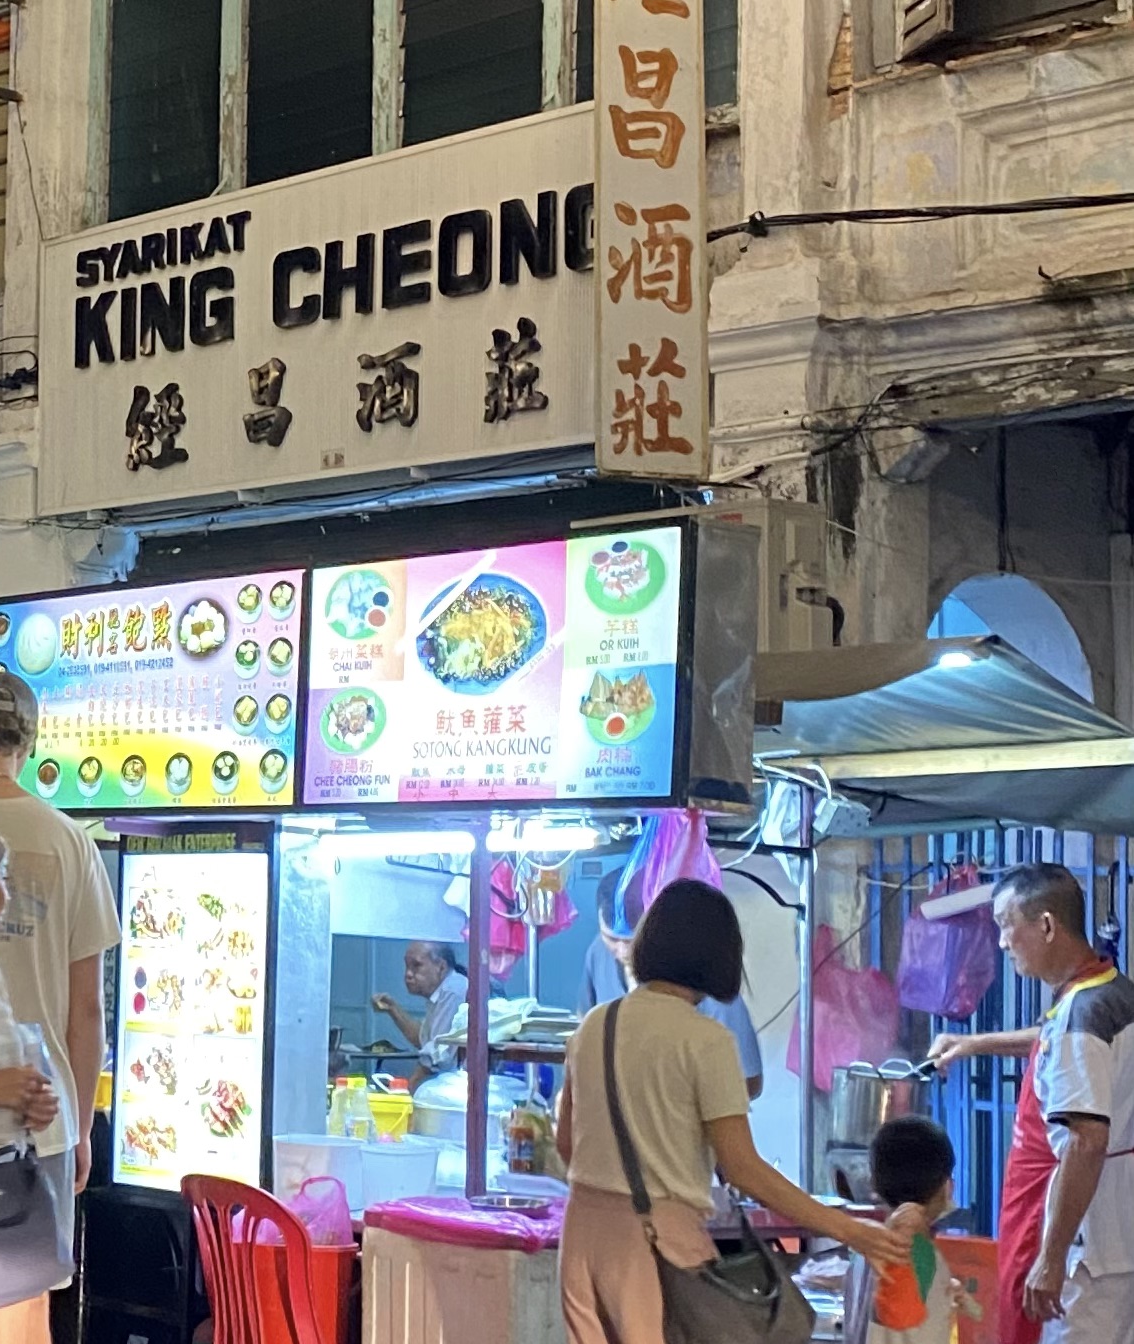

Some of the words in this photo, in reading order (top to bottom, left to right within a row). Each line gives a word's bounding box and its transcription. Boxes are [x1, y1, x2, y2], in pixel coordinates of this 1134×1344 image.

[76, 210, 252, 289] SYARIKAT
[74, 266, 235, 369] KING
[600, 640, 614, 651] OR
[617, 638, 640, 650] KUIH
[333, 661, 352, 673] CHAI
[413, 740, 461, 759] SOTONG
[466, 736, 552, 757] KANGKUNG
[585, 766, 602, 778] BAK
[605, 766, 641, 778] CHANG
[314, 776, 334, 787] CHEE
[337, 775, 371, 787] CHEONG
[375, 775, 390, 786] FUN
